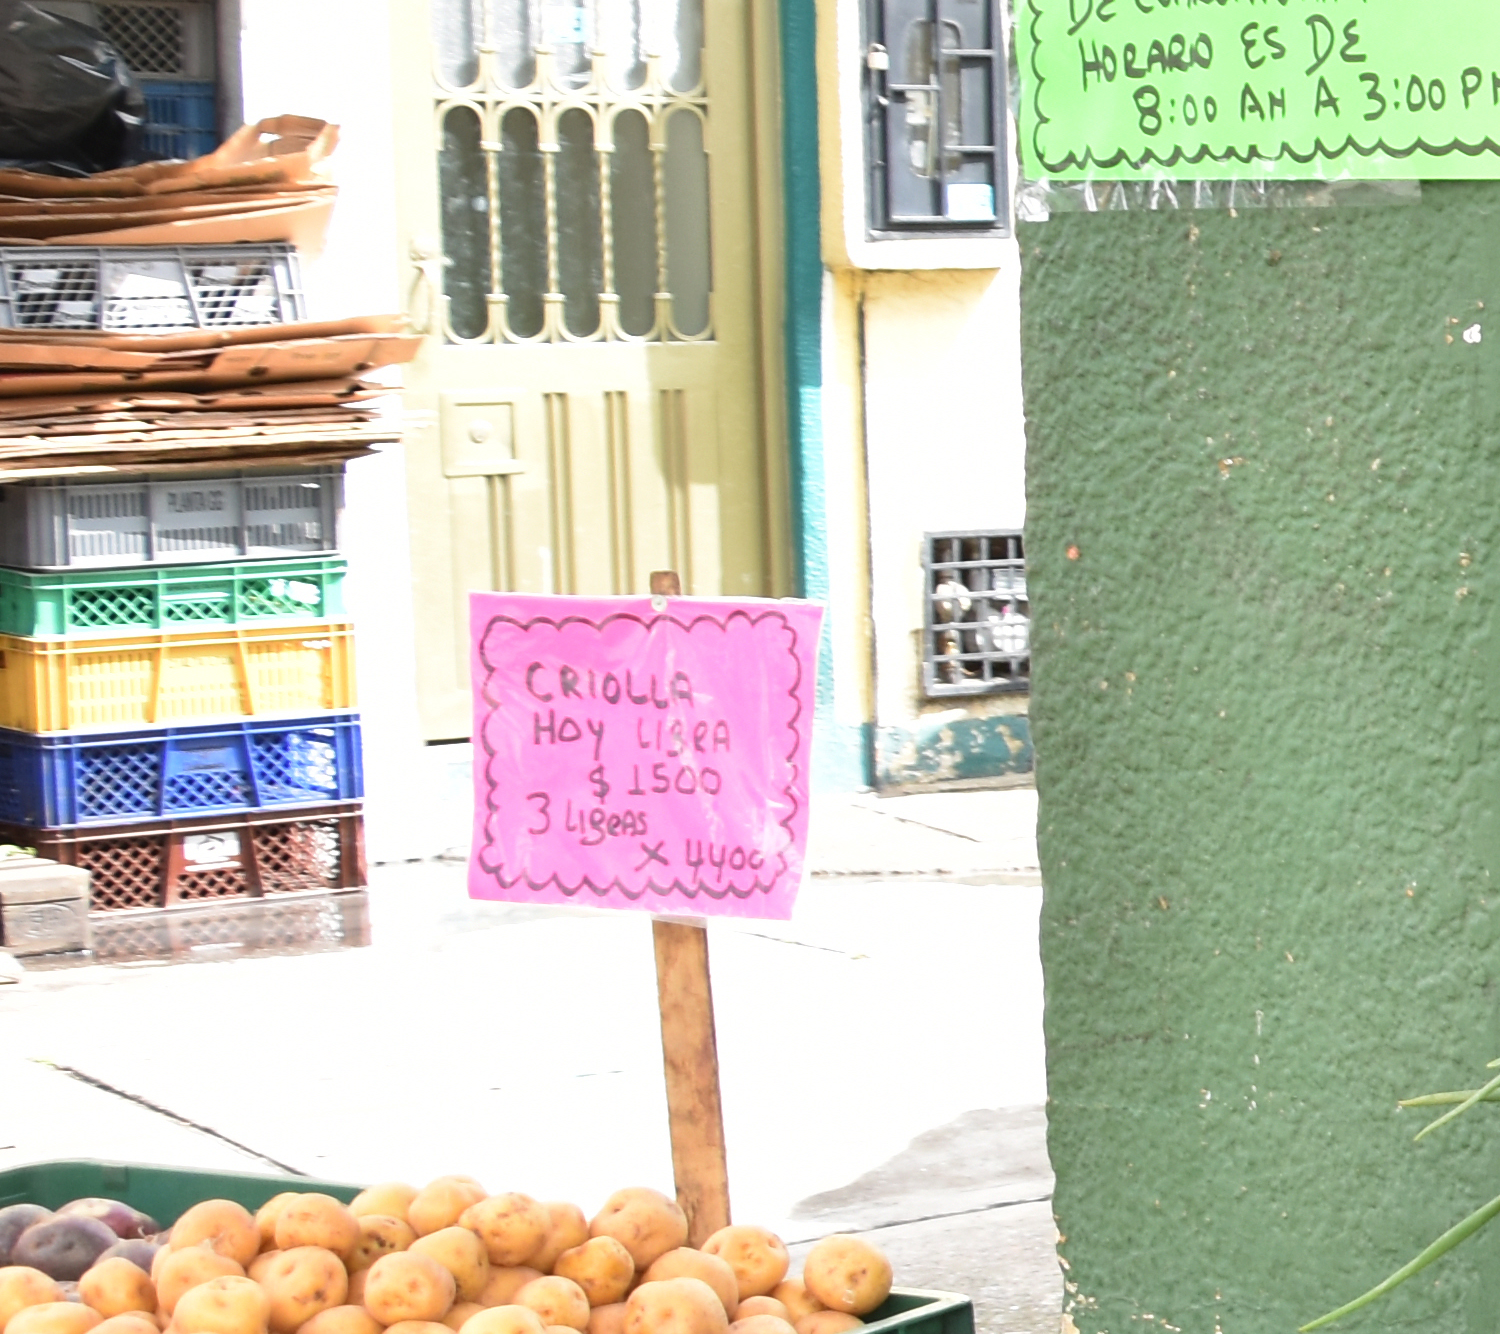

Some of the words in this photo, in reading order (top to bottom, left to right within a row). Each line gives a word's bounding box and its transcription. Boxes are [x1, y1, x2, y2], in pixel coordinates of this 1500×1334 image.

[1240, 21, 1287, 70] ES
[1305, 15, 1367, 75] DE
[1133, 84, 1218, 137] 8:00
[1240, 82, 1287, 122] AM
[1313, 76, 1340, 119] A
[1358, 72, 1446, 121] 3:00
[526, 662, 694, 709] CRIOLLA
[533, 709, 604, 761] HOY
[589, 770, 610, 805] $
[628, 763, 722, 796] 1500
[527, 792, 551, 835] 3
[685, 838, 764, 884] 4400
